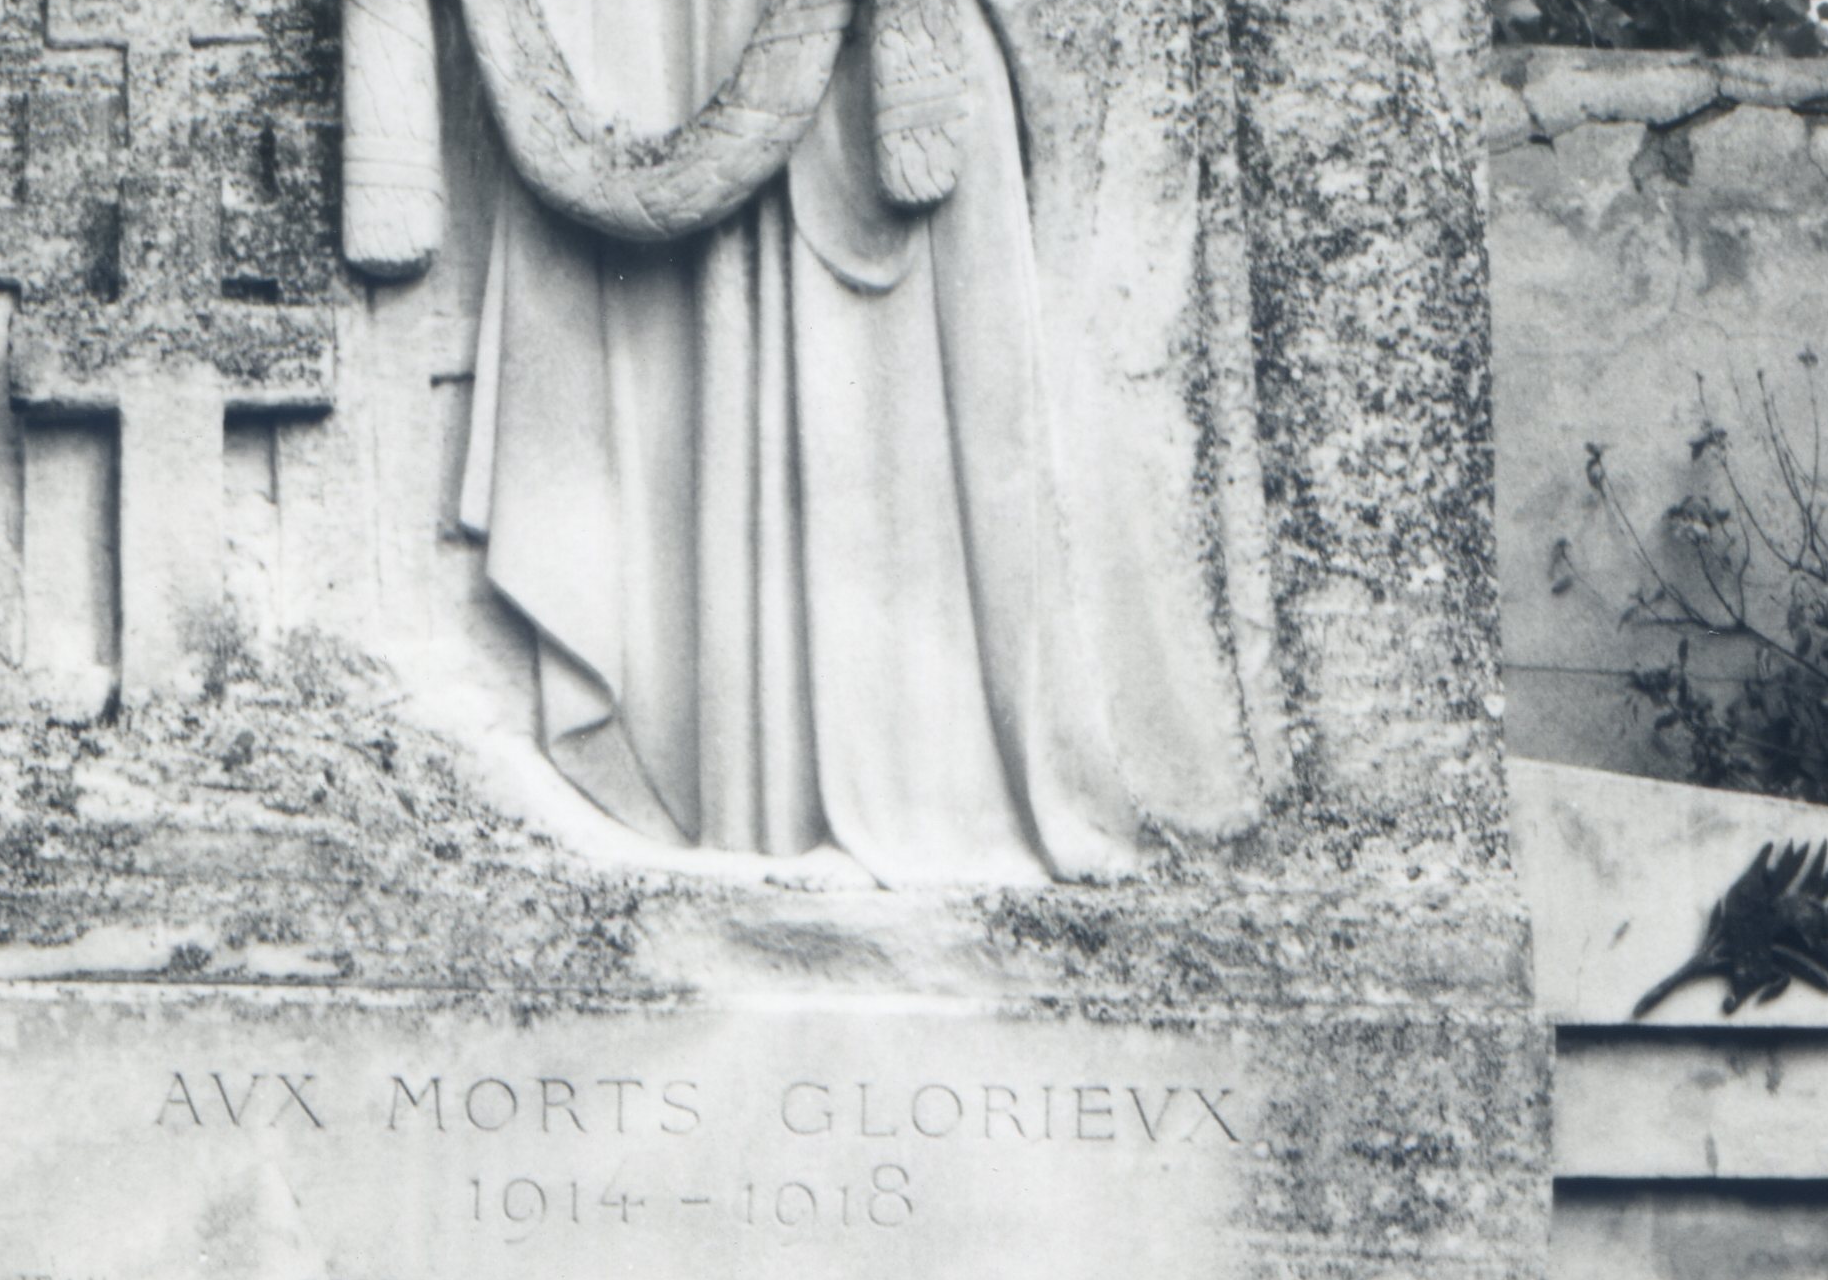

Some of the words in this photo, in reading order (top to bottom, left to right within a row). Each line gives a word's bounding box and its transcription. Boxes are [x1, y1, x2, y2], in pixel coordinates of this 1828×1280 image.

[155, 1071, 327, 1130] AVX
[387, 1074, 702, 1135] MORTS
[779, 1080, 1242, 1143] GLORIEVX
